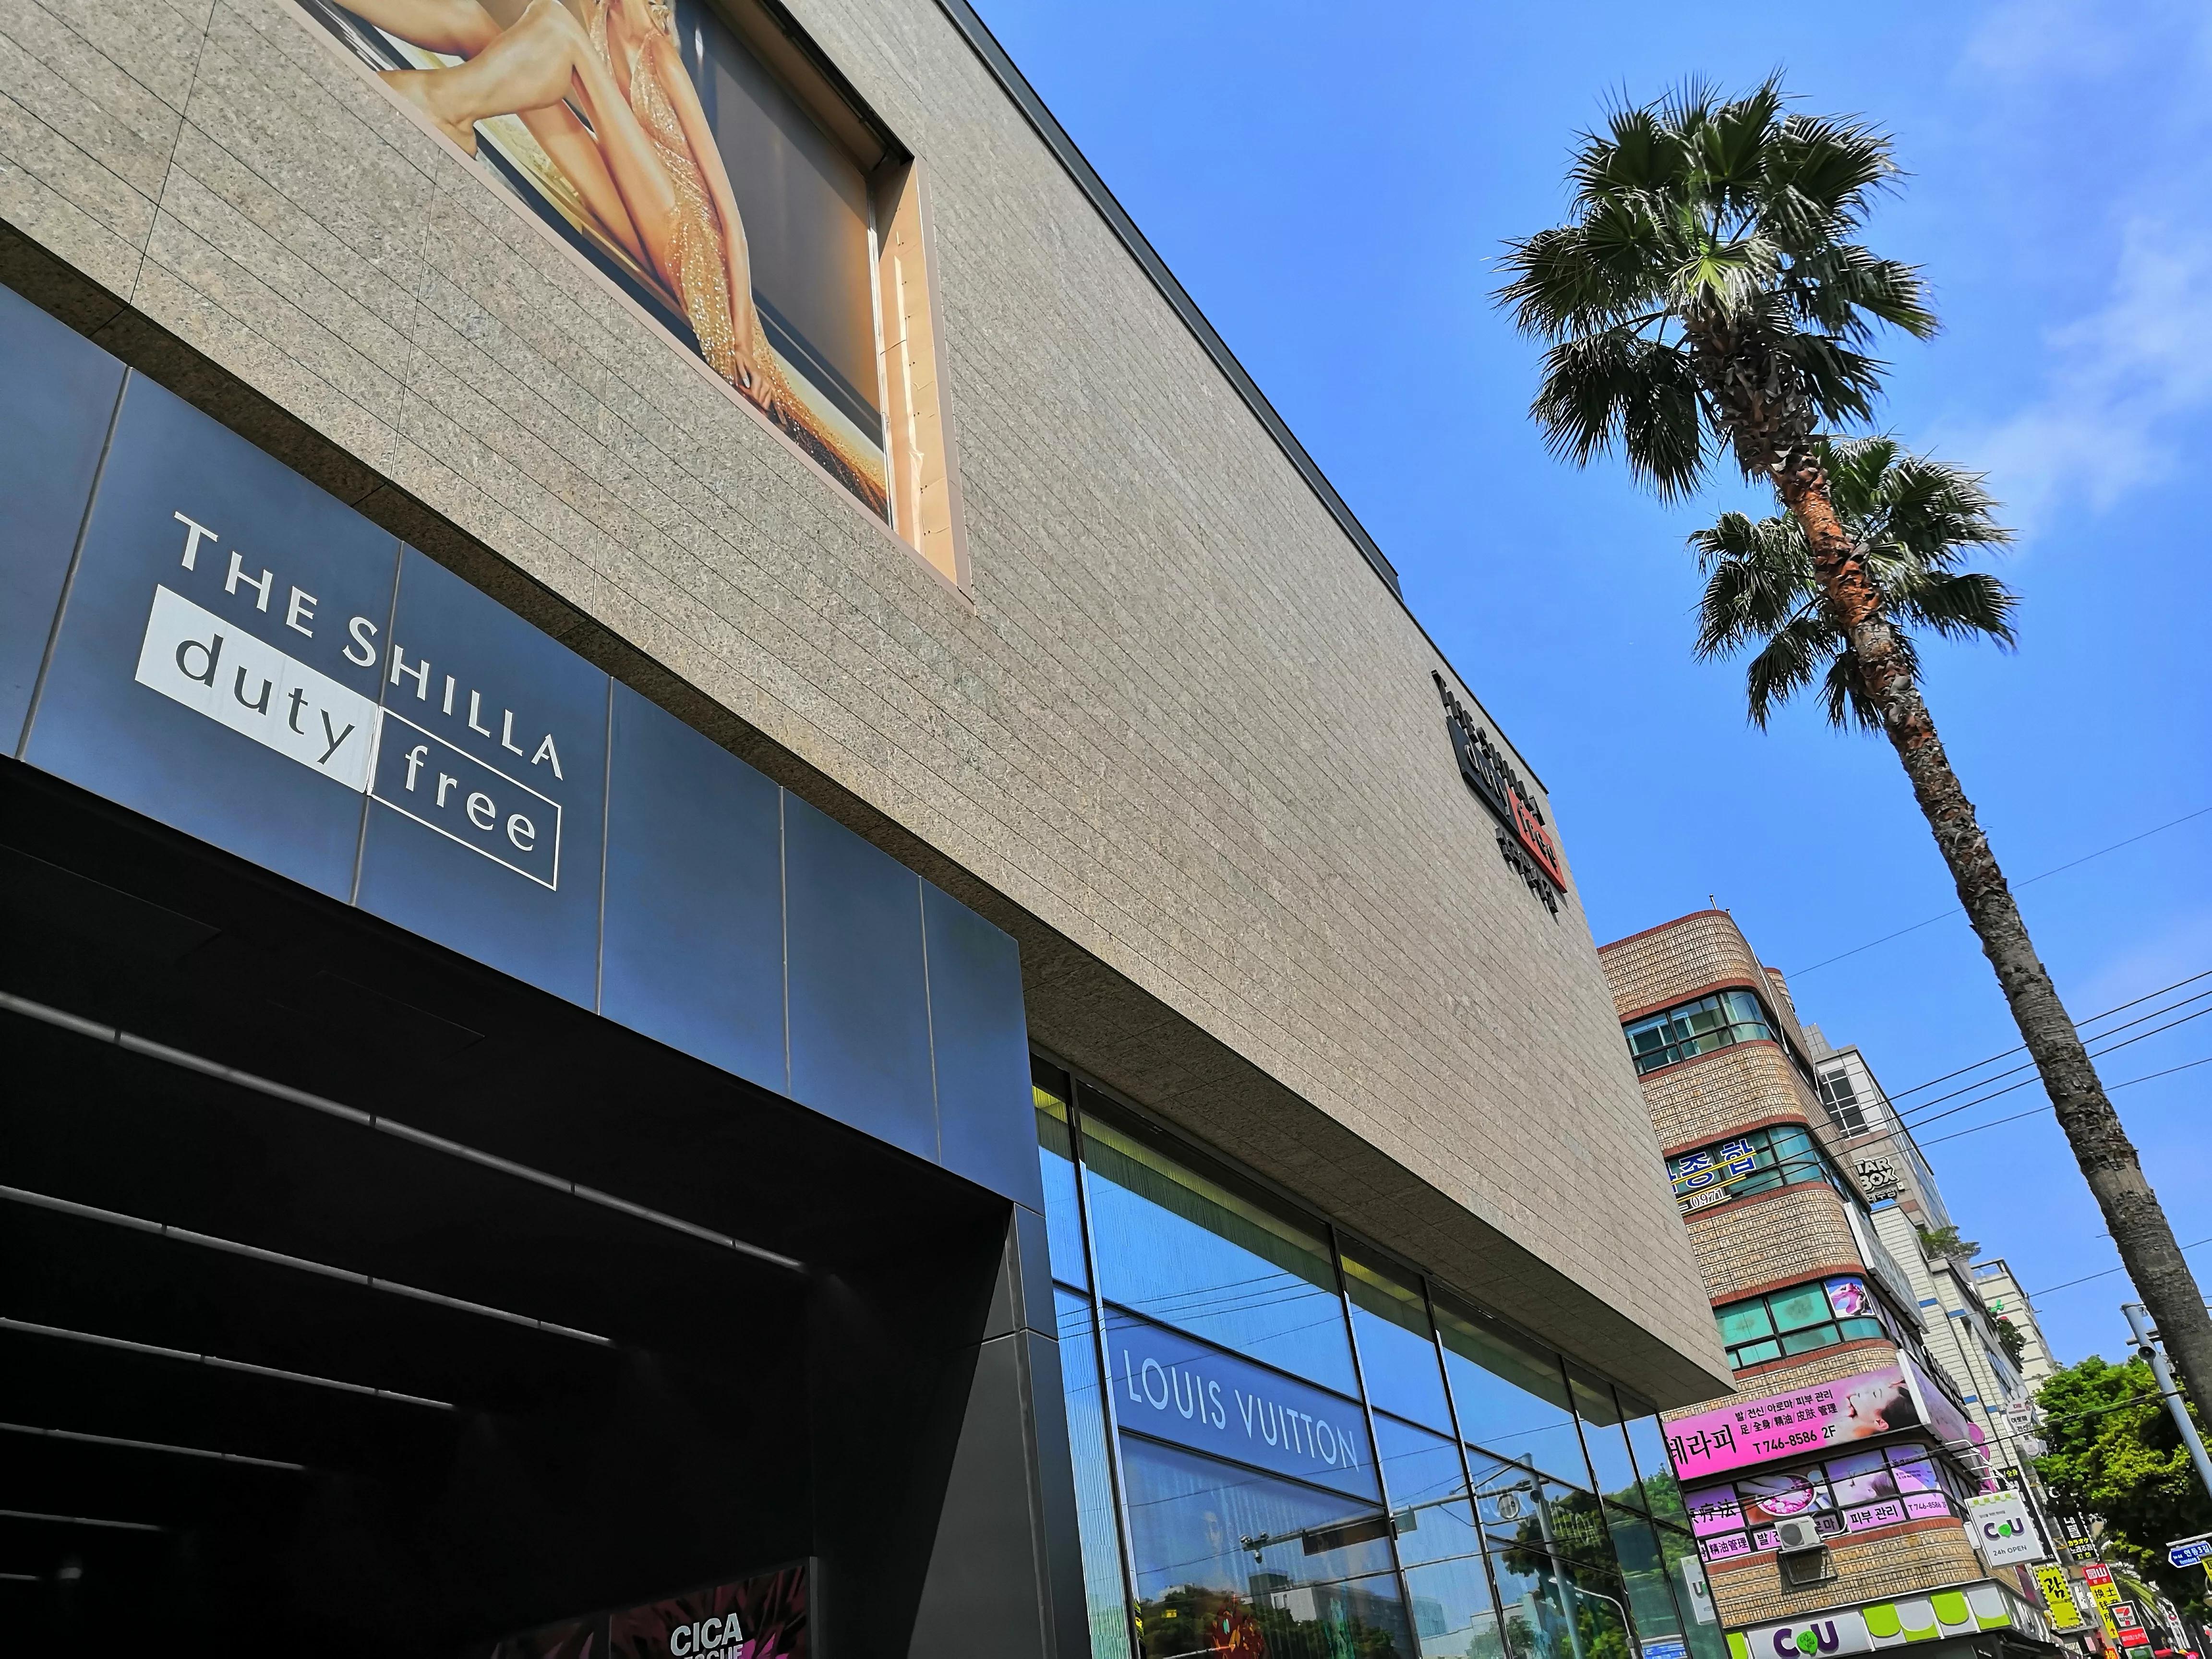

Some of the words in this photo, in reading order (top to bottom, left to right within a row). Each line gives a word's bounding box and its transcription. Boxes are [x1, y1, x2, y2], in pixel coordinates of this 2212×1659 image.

[174, 511, 317, 637] THE
[343, 616, 563, 780] SHILLA
[176, 634, 355, 765] duty
[405, 745, 535, 851] free
[1431, 669, 1479, 744] THE
[1476, 726, 1545, 826] SHILLA
[1464, 741, 1511, 817] duty
[1517, 802, 1559, 869] free
[1859, 1169, 1896, 1190] BOX
[1815, 1389, 1833, 1402] 관리
[1818, 1403, 1838, 1416] 管理
[1124, 1349, 1226, 1430] LOUIS
[1235, 1389, 1359, 1473] VUITTON
[1753, 1443, 1761, 1454] T
[1763, 1432, 1817, 1452] 746-8586
[1821, 1425, 1837, 1439] 2F
[1850, 1511, 1873, 1524] 피부
[1875, 1504, 1898, 1521] 관리
[1914, 1502, 1941, 1510] 746-8586
[1984, 1517, 2024, 1539] CU
[2008, 1545, 2027, 1553] OPEN
[671, 1612, 743, 1657] CICA
[1773, 1621, 1839, 1657] CU
